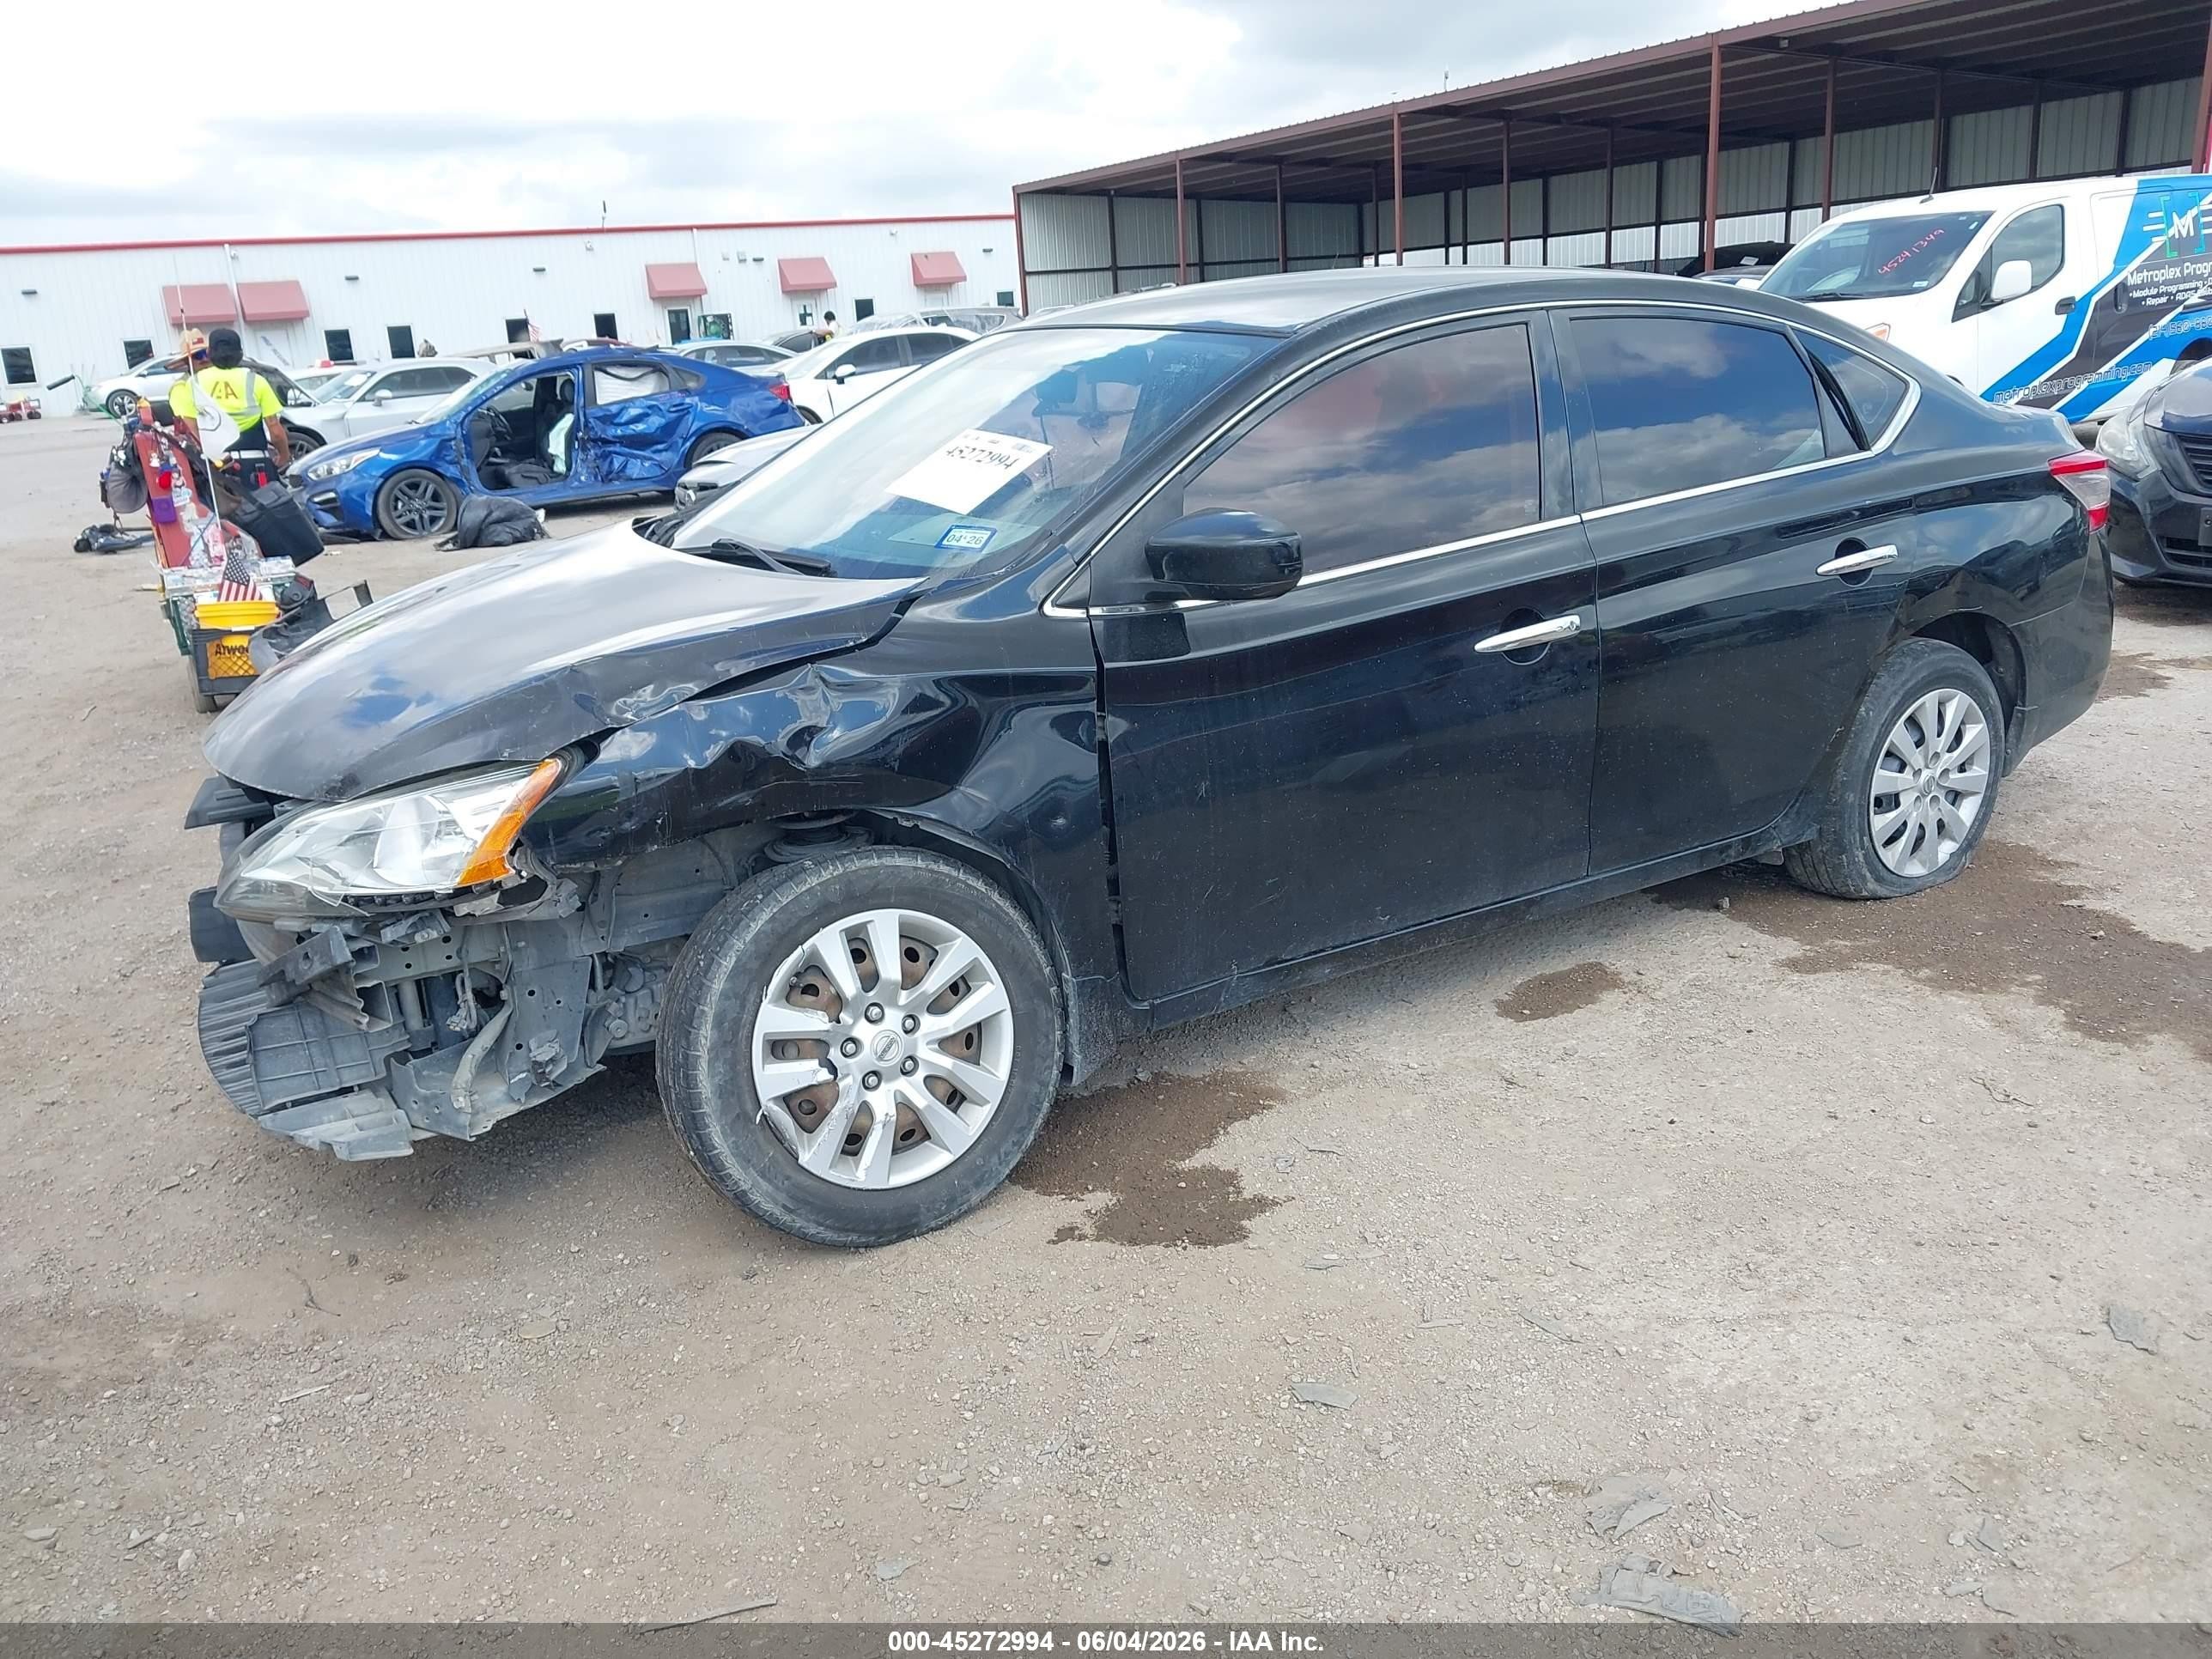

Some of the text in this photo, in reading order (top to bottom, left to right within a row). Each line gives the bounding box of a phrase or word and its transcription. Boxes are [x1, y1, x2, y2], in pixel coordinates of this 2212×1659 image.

[2127, 264, 2181, 287] Metroplex
[2132, 286, 2158, 299] Module
[2159, 280, 2203, 295] Programming
[2146, 294, 2170, 307] Repair
[1993, 361, 2153, 404] metroplexprogramming.com
[946, 446, 1020, 470] 45272994
[946, 534, 984, 546] 04 26
